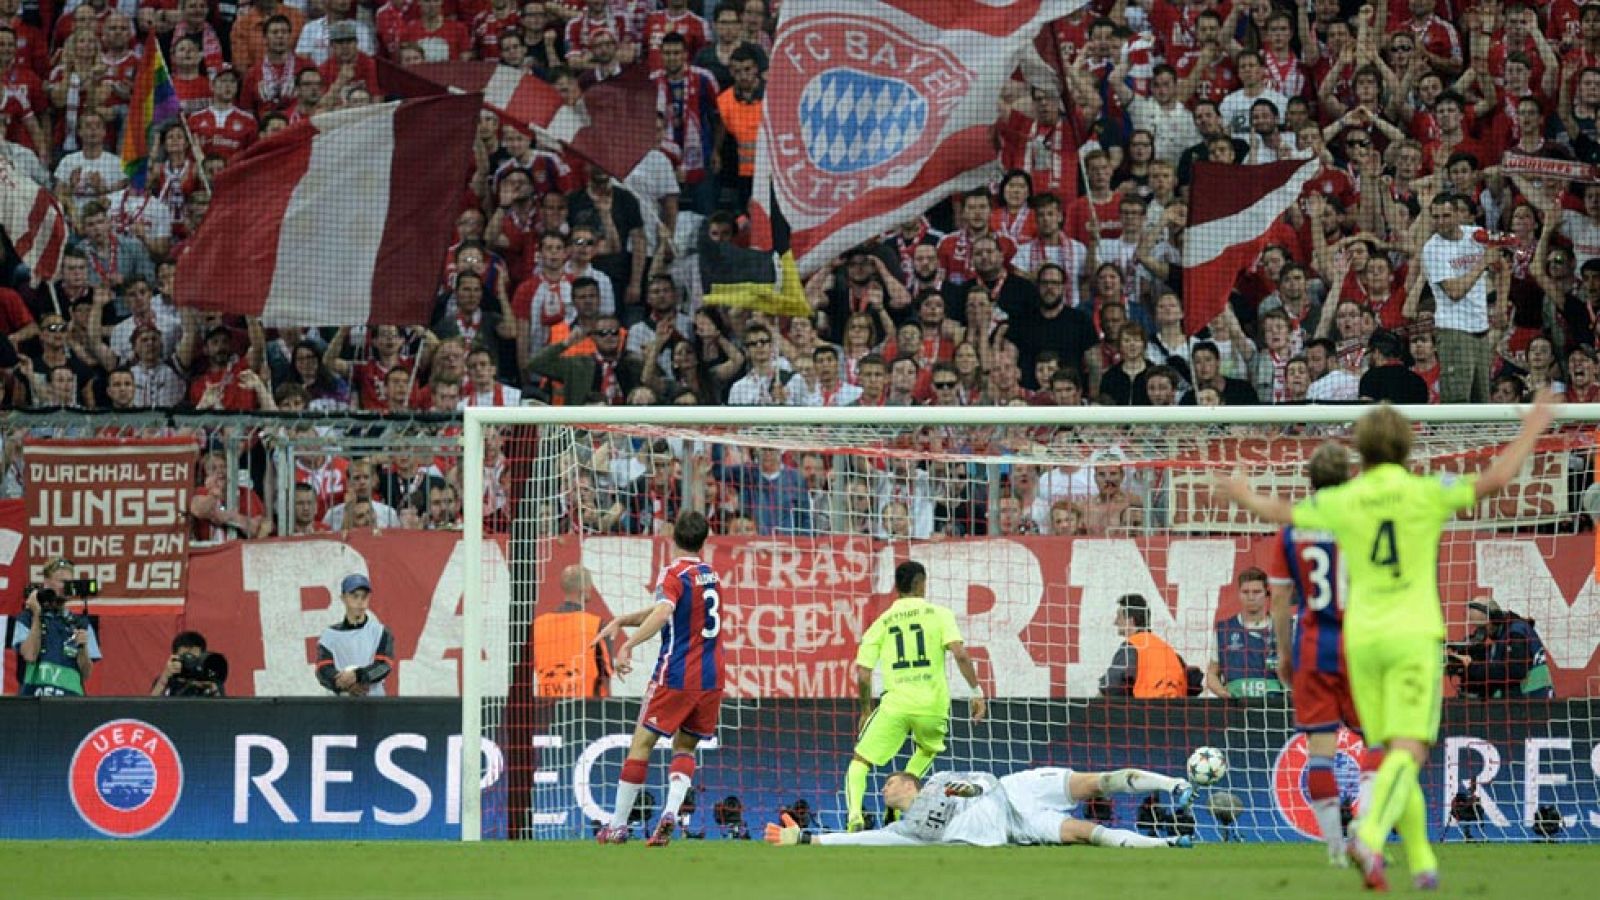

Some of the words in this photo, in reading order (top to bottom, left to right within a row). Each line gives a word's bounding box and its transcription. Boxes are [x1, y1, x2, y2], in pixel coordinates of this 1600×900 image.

[785, 33, 832, 74] FC
[29, 463, 189, 483] DURCHHALTEN
[29, 489, 187, 526] JUNGS!
[29, 535, 65, 558] NO
[73, 535, 125, 557] ONE
[133, 533, 185, 556] CAN
[704, 539, 869, 589] TRAS
[1371, 519, 1401, 578] 4
[30, 563, 117, 590] SOP
[126, 561, 182, 590] US!
[242, 538, 1235, 698] BAYRN
[701, 587, 720, 638] 3
[722, 598, 869, 652] EGEN
[887, 623, 932, 671] 11
[39, 663, 62, 683] TV
[92, 727, 158, 754] UEFA
[1443, 737, 1600, 828] RE
